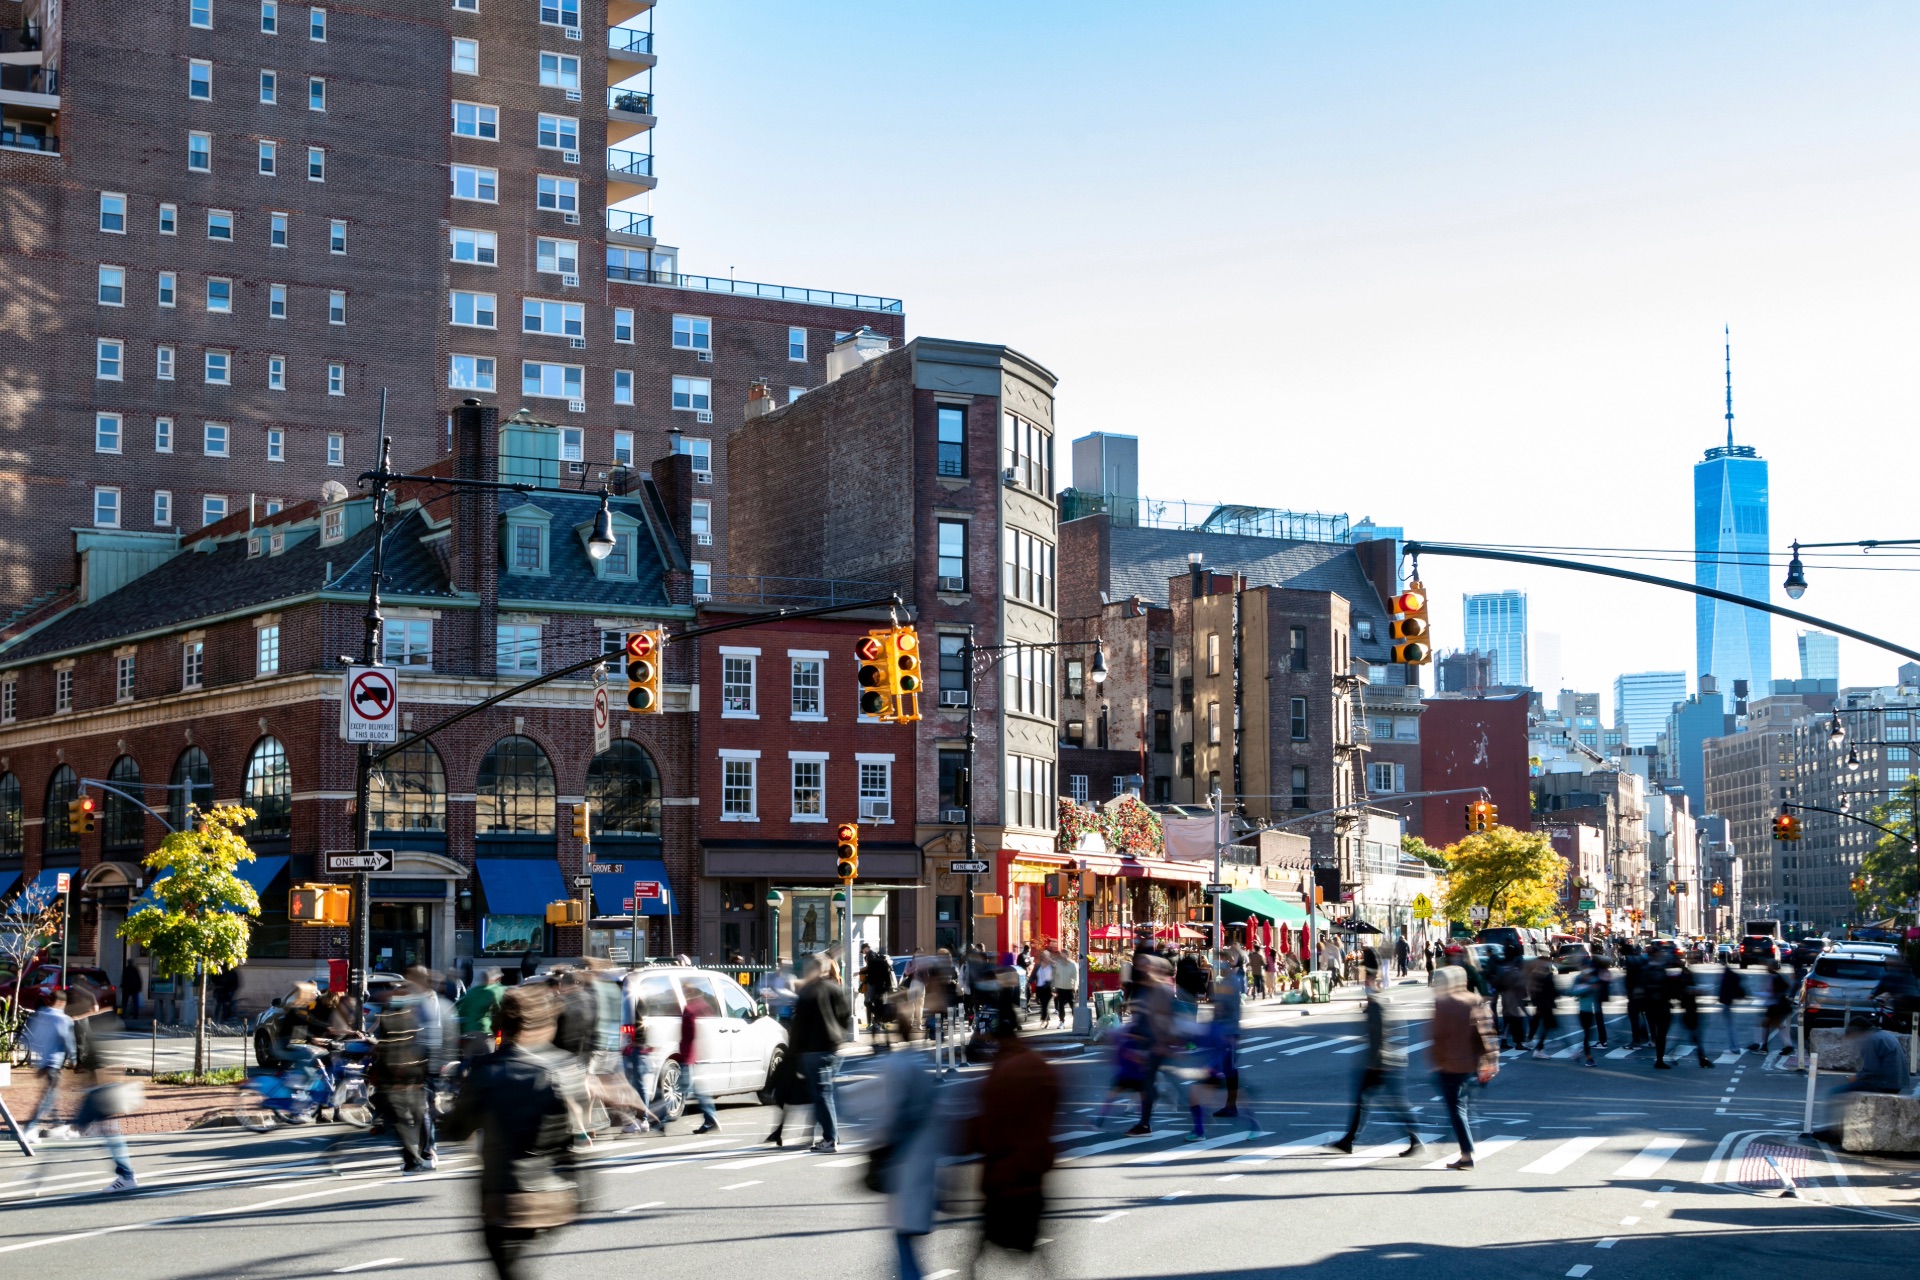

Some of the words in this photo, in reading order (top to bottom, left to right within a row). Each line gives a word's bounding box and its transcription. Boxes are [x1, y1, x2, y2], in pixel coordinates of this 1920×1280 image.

[350, 722, 367, 730] EXCEPT
[368, 723, 394, 731] DELIVERIES
[355, 731, 368, 739] THIS
[335, 857, 355, 867] ONE
[363, 856, 383, 867] WAY
[592, 864, 612, 873] GROVE
[614, 864, 623, 873] ST
[332, 937, 342, 945] 74
